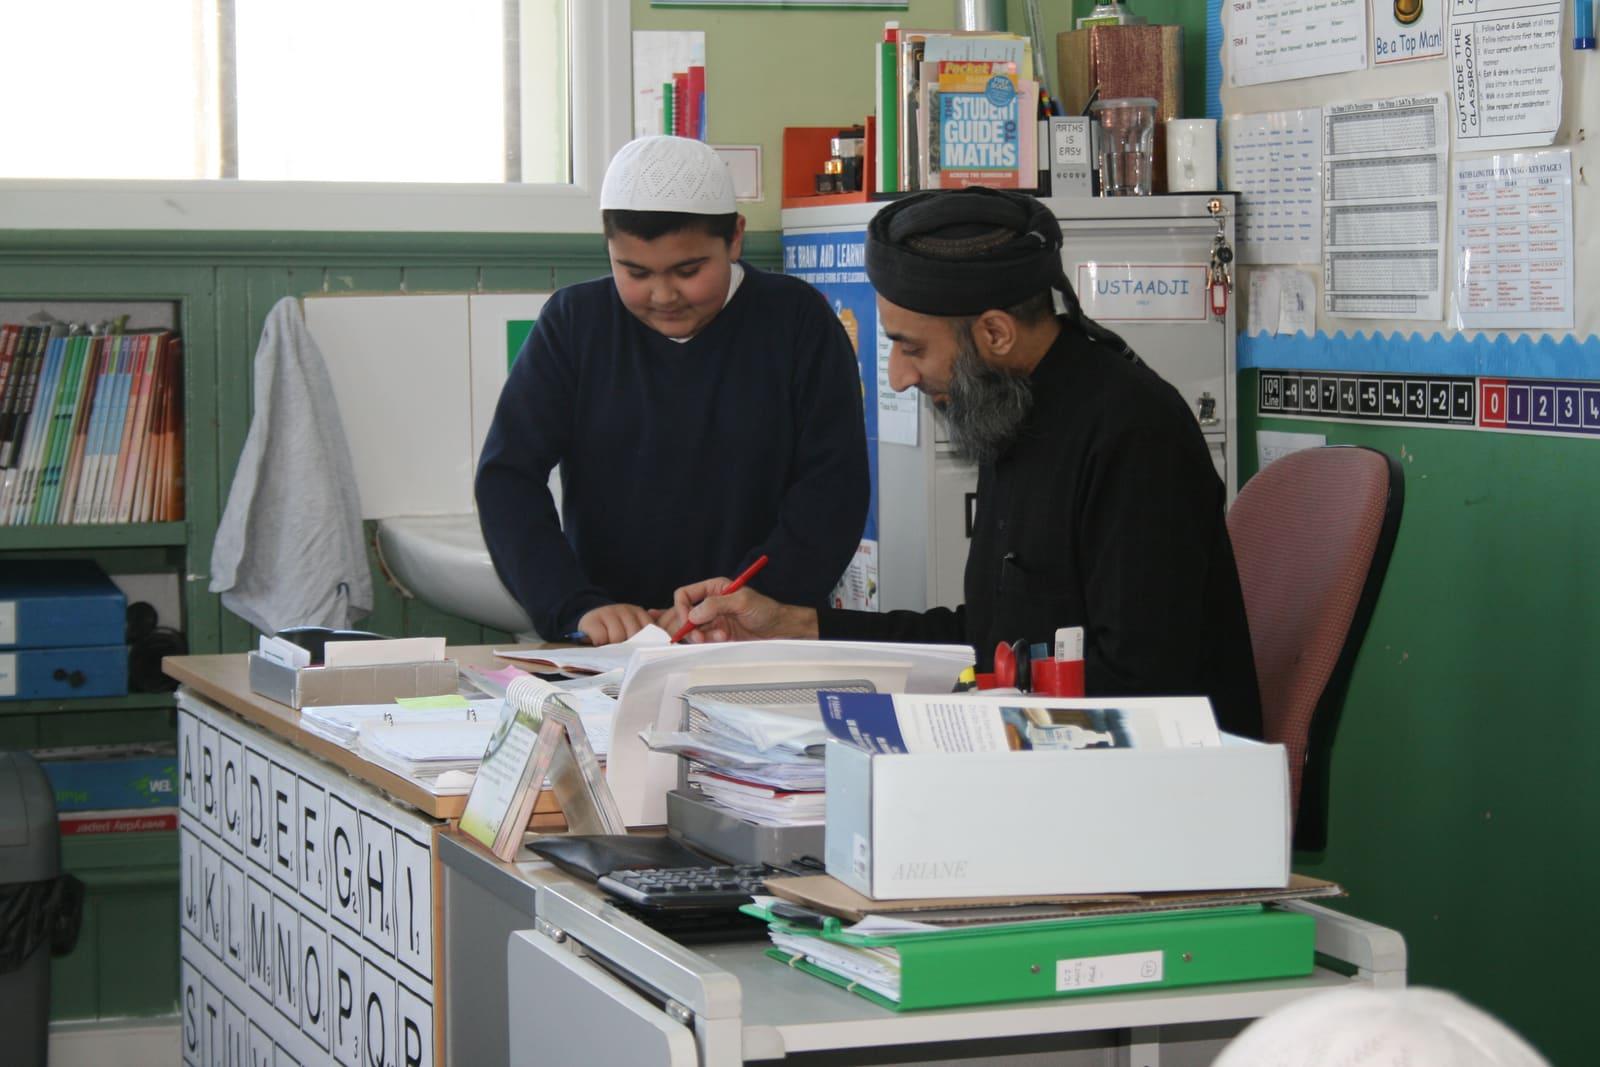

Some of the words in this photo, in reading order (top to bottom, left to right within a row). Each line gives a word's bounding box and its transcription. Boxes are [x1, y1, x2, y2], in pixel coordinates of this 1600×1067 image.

[1376, 37, 1388, 55] Be
[1391, 41, 1396, 53] a
[1399, 35, 1416, 55] Top
[1419, 28, 1442, 48] Man!
[1454, 28, 1462, 59] THE
[1496, 23, 1510, 31] Quran
[944, 62, 990, 74] Pocket
[1456, 65, 1466, 134] OUTSIDE
[1465, 34, 1476, 126] CLASSROOM
[945, 120, 1004, 143] GUIDE
[1005, 120, 1016, 142] TO
[953, 97, 1015, 121] STUDENT
[1055, 124, 1084, 132] MATHS
[945, 143, 1015, 166] MATHS
[1058, 147, 1081, 156] EASY
[1097, 280, 1189, 295] USTAADJI
[1264, 393, 1279, 406] Line
[1285, 382, 1299, 402] -9
[1304, 384, 1317, 404] -8
[1324, 385, 1336, 405] -7
[1342, 386, 1354, 406] -6
[1362, 386, 1377, 407] -5
[1386, 386, 1401, 408] -4
[1410, 388, 1424, 410] -3
[1432, 390, 1447, 410] -2
[1458, 390, 1468, 412] -1
[1490, 392, 1499, 413] 0
[1516, 394, 1521, 415] 1
[1539, 396, 1547, 417] 2
[1565, 397, 1573, 418] 3
[1591, 398, 1599, 419] 4
[183, 734, 194, 801] A
[204, 745, 214, 814] B
[225, 760, 237, 832] C
[76, 821, 110, 833] paper
[114, 820, 166, 832] everyday
[250, 775, 263, 848] D
[276, 790, 289, 868] E
[304, 806, 316, 882] F
[186, 856, 193, 919] J
[334, 827, 352, 908] G
[367, 843, 384, 932] H
[892, 860, 968, 881] ARIANE
[205, 867, 216, 940] K
[228, 884, 238, 958] L
[407, 866, 413, 951] I
[251, 904, 265, 982] M
[278, 923, 292, 1004] N
[305, 945, 321, 1025] O
[338, 968, 352, 1046] P
[186, 985, 196, 1053] S
[367, 992, 385, 1067] Q
